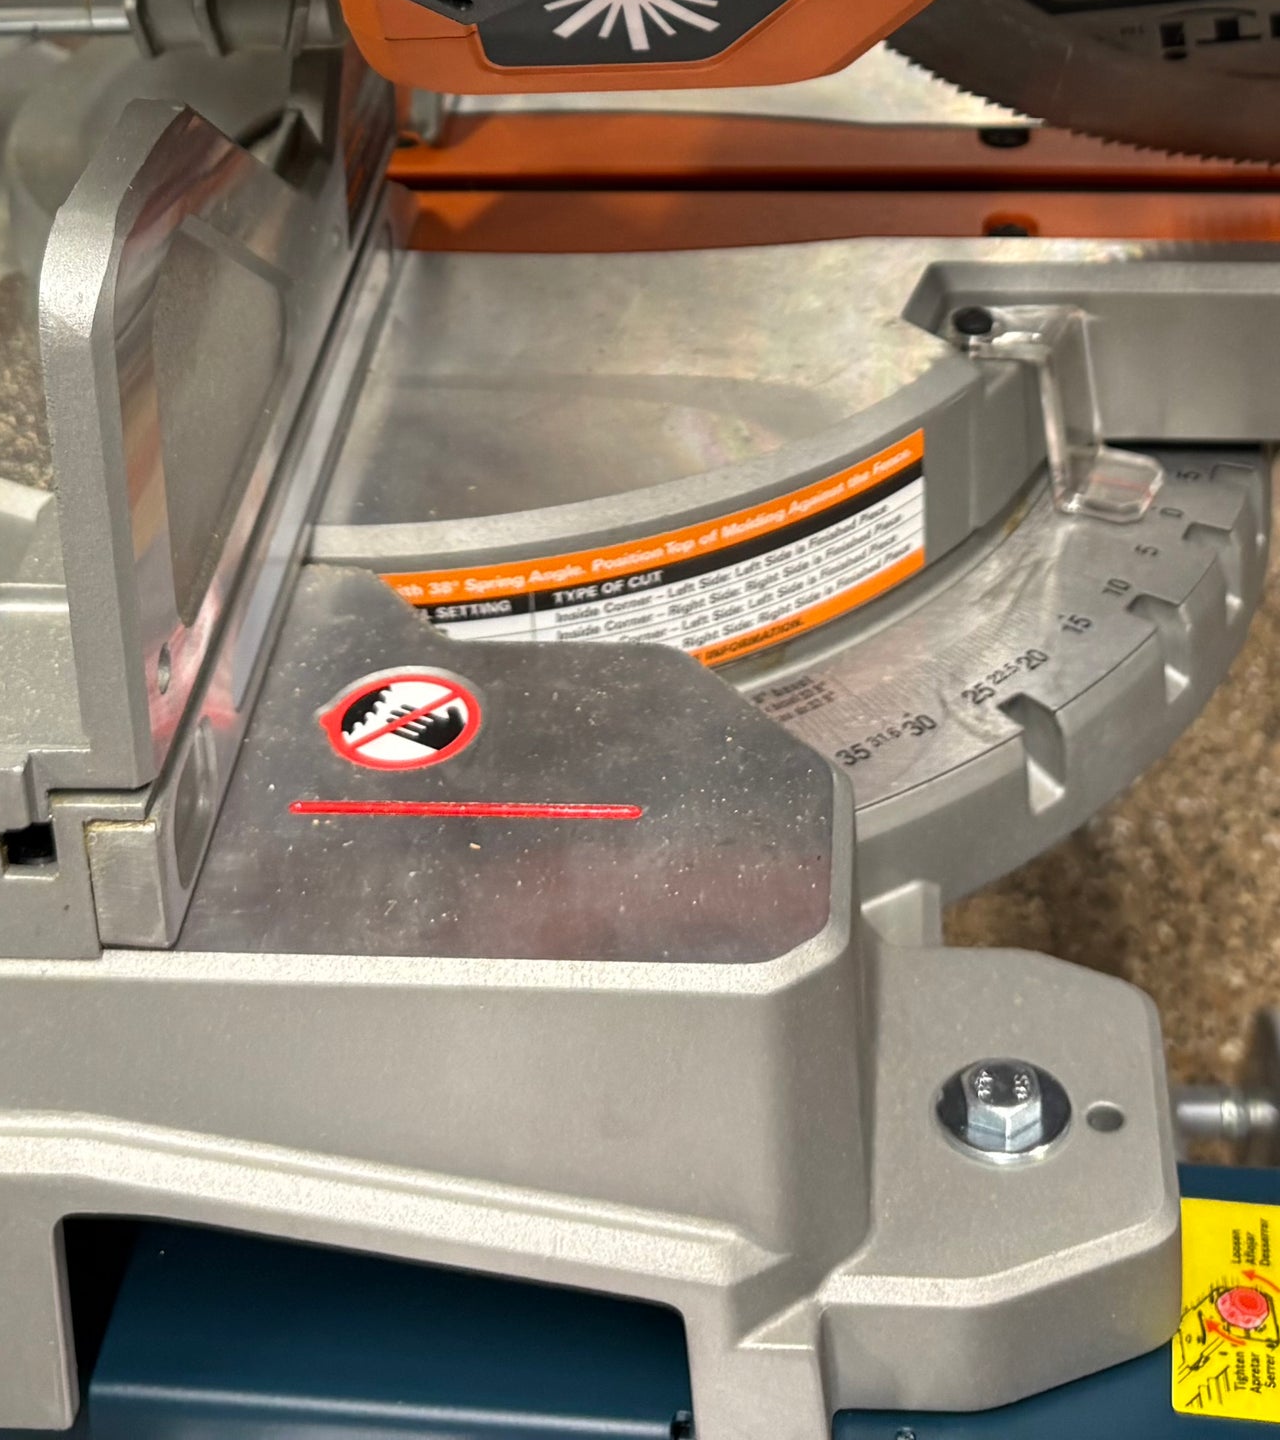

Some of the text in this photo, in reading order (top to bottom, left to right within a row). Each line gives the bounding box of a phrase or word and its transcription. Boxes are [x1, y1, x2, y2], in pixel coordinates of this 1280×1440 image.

[464, 574, 526, 593] Spring
[664, 539, 696, 555] Top
[698, 528, 718, 545] of
[552, 570, 665, 604] TYPE OF CUT
[1102, 577, 1133, 597] 10
[435, 600, 512, 620] SETTING
[1062, 615, 1094, 635] 15
[961, 684, 997, 707] 25
[1016, 648, 1052, 672] 20
[835, 743, 871, 767] 35
[902, 713, 939, 737] 30
[1234, 1350, 1247, 1392] Tighten
[1250, 1352, 1262, 1394] Apretar
[1264, 1354, 1277, 1389] Serrer
